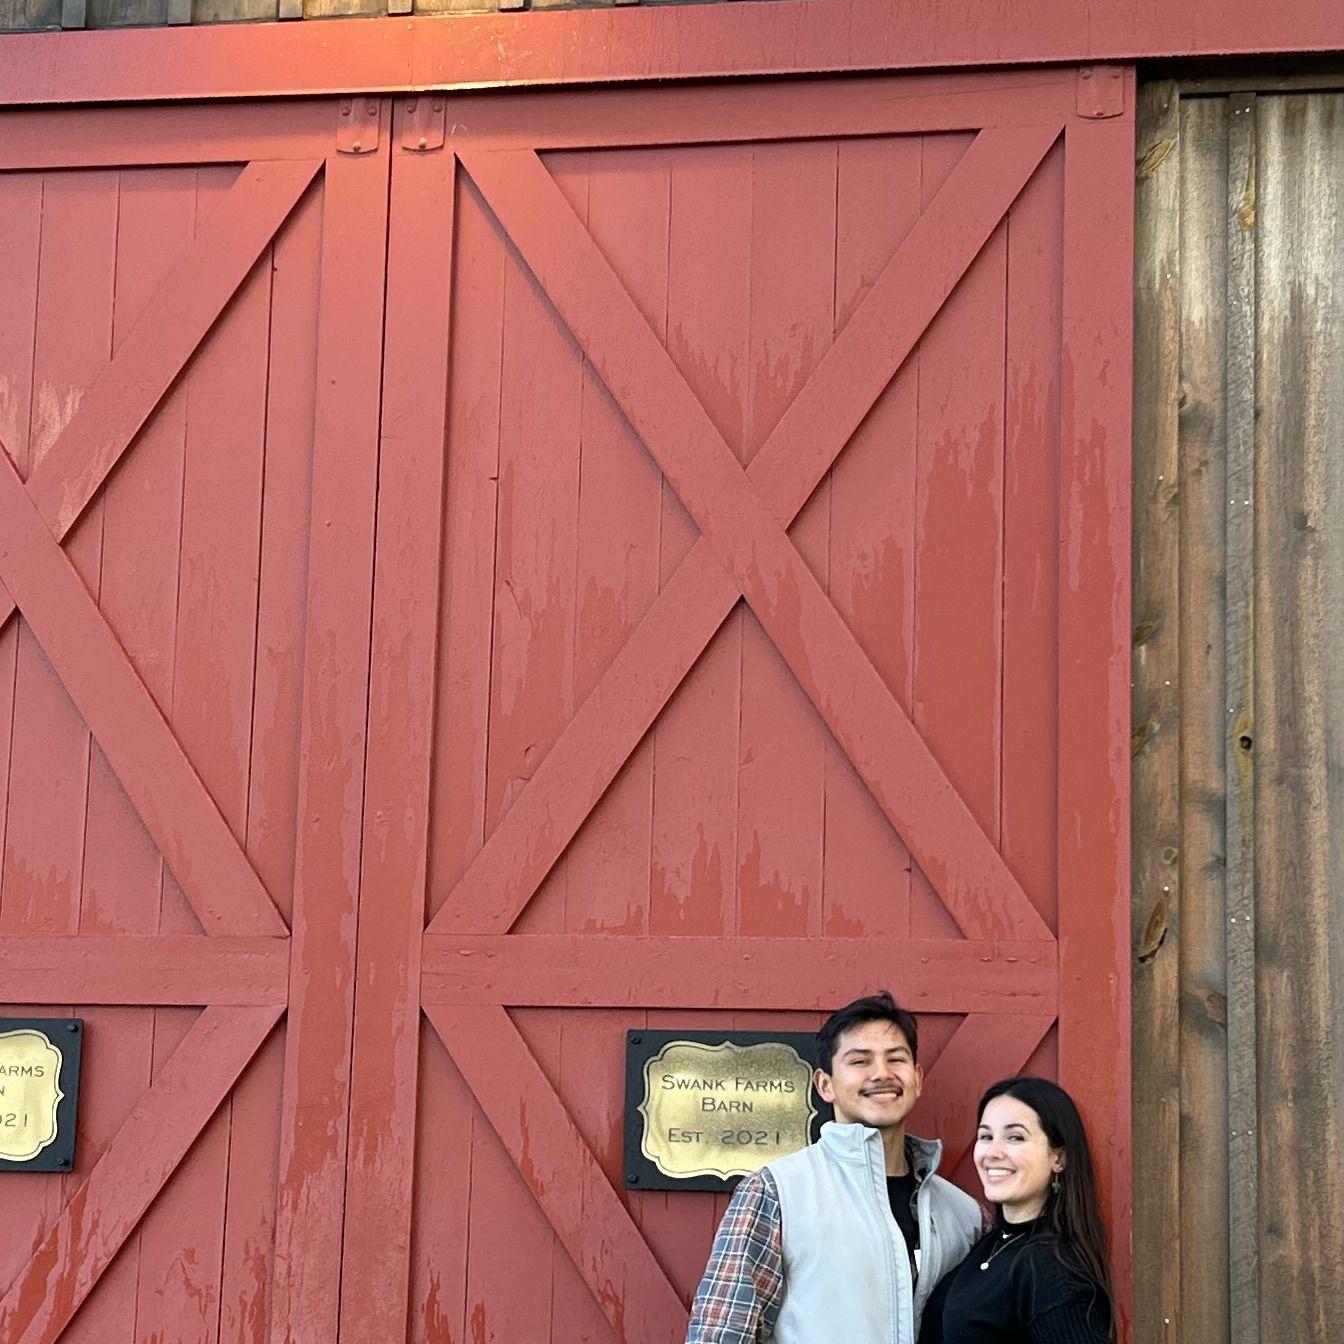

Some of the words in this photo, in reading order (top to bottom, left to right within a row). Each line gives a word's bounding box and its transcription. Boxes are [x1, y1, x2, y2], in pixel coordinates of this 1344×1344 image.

[661, 1074, 725, 1091] SWANK
[735, 1076, 795, 1093] FARMS
[701, 1097, 754, 1113] BARN
[721, 1129, 780, 1145] 2021
